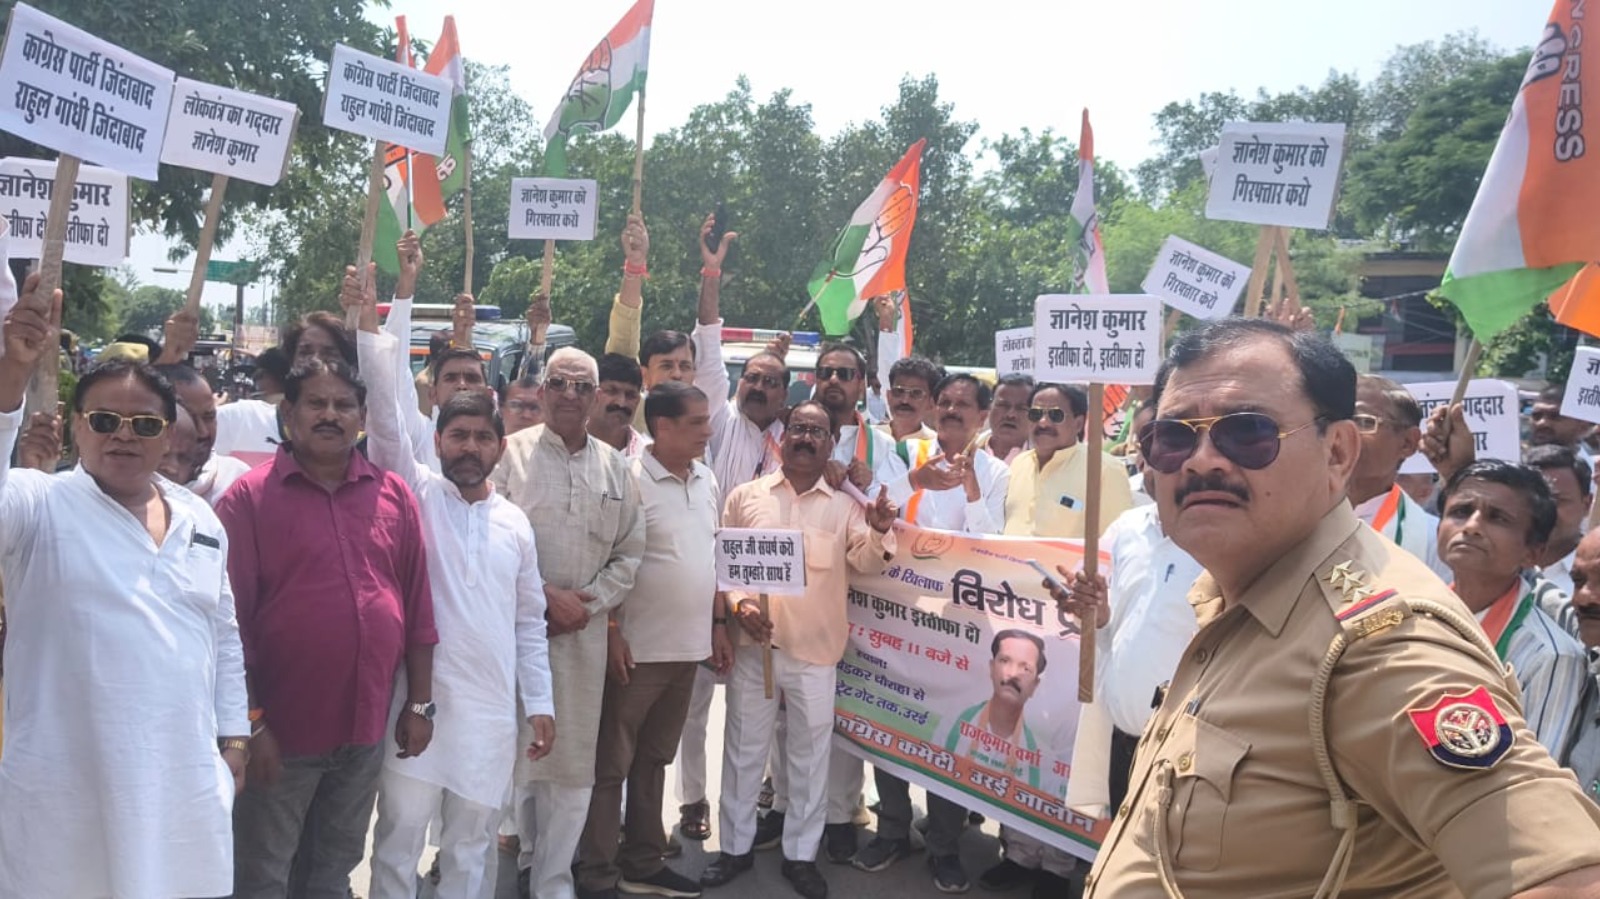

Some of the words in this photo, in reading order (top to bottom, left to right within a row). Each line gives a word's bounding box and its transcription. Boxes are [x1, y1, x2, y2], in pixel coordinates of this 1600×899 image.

[69, 51, 101, 87] पार्टी
[100, 58, 156, 110] जिंदाबाद
[376, 72, 398, 95] पार्टी
[399, 76, 440, 108] जिंदाबाद
[15, 81, 54, 124] राहुल
[54, 91, 89, 133] गांधी
[90, 102, 147, 153] जिंदाबाद
[183, 91, 225, 121] लोकतंत्र
[227, 105, 244, 126] का
[341, 94, 367, 122] राहुल
[368, 99, 393, 126] गांधी
[394, 105, 435, 137] जिंदाबाद
[192, 128, 227, 155] ज्ञानेश
[227, 139, 260, 166] कुमार
[1233, 135, 1272, 165] ज्ञानेश
[1273, 143, 1309, 174] कुमार
[1309, 137, 1329, 168] को
[549, 190, 573, 209] कुमार
[574, 186, 587, 205] को
[1233, 174, 1285, 205] गिरफ्तार
[1286, 176, 1311, 207] करो
[97, 218, 110, 247] दो
[562, 210, 580, 228] करो
[1196, 262, 1223, 284] कुमार
[1221, 271, 1236, 289] को
[1199, 291, 1218, 310] करो
[1050, 303, 1099, 330] ज्ञानेश
[1102, 310, 1147, 338] कुमार
[1048, 341, 1080, 369] इस्तीफा
[1099, 342, 1132, 371] इस्तीफा
[1134, 342, 1146, 369] दो
[722, 539, 743, 560] राहुल
[745, 536, 756, 555] जी
[779, 537, 794, 556] करो
[728, 565, 740, 579] हम
[766, 566, 783, 581] साथ
[951, 568, 1046, 626] विरोध
[870, 594, 908, 621] कुमार
[964, 620, 981, 644] दो
[955, 655, 969, 671] से
